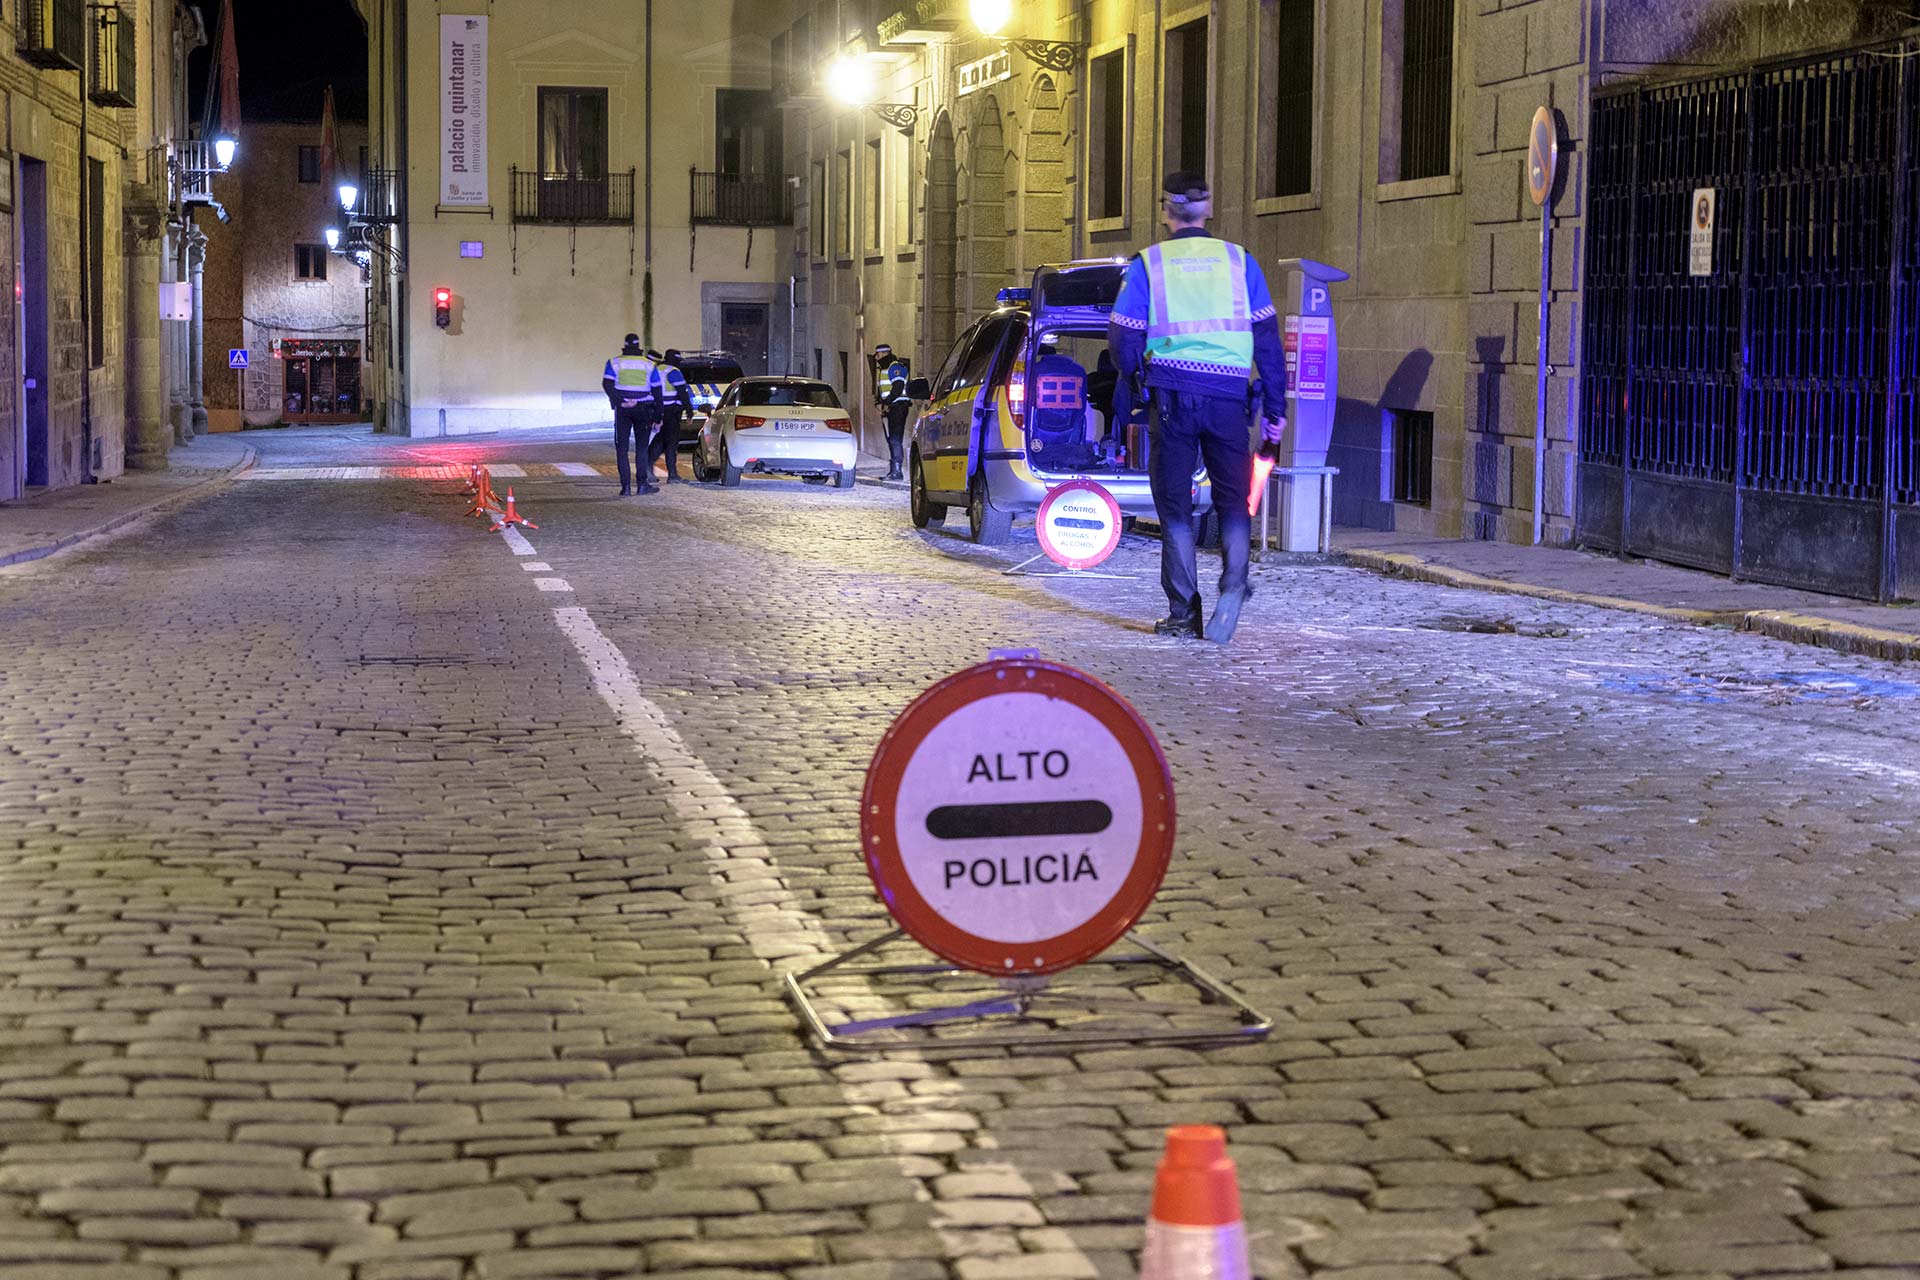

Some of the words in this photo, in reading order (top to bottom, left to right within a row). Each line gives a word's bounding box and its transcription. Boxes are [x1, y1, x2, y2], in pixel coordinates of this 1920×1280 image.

[471, 43, 481, 77] cultura
[448, 40, 468, 114] quintanar
[470, 87, 481, 118] diseño
[448, 118, 468, 173] palacio
[1310, 287, 1327, 312] P
[780, 422, 799, 430] 1589
[1062, 505, 1096, 514] CONTROL
[1058, 530, 1089, 539] DROGAS
[1060, 540, 1094, 549] ALCOHOL
[967, 750, 1070, 783] ALTO
